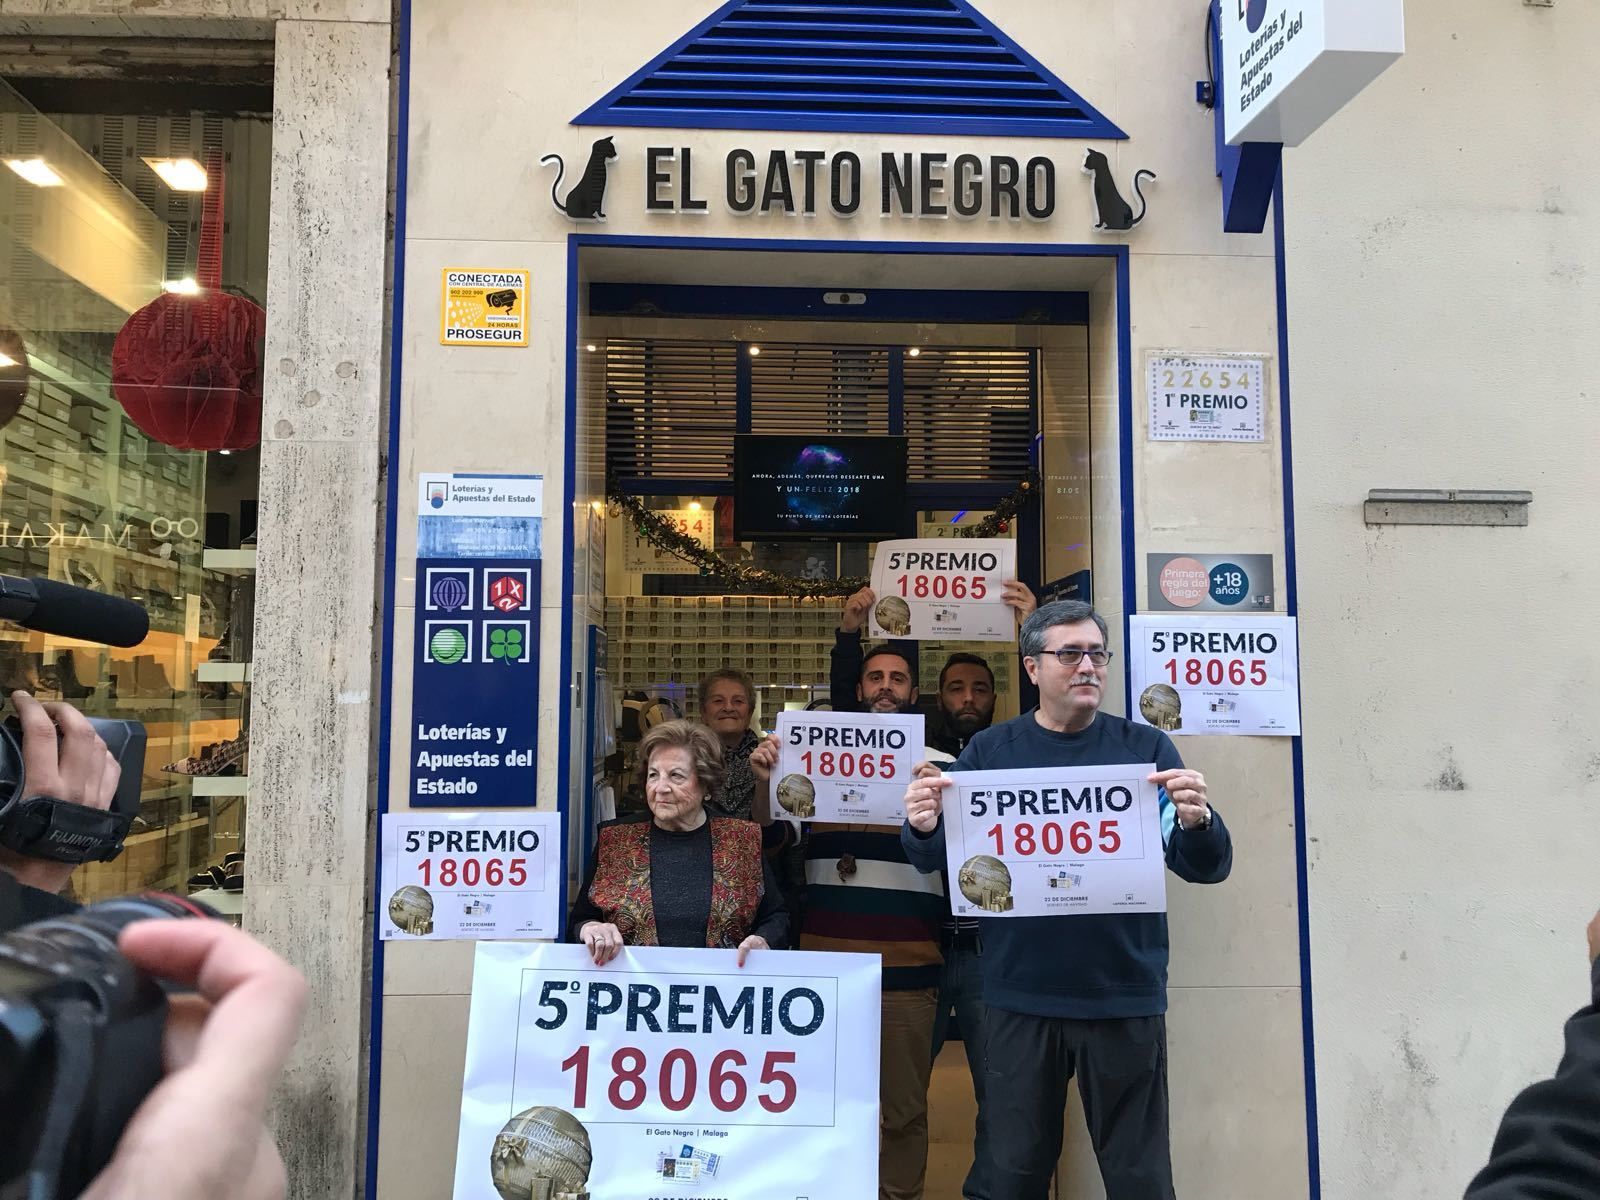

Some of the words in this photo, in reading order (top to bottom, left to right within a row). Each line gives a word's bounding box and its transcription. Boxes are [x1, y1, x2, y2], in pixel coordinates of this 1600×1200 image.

[1239, 19, 1278, 70] Loterías
[1280, 8, 1287, 31] y
[1240, 35, 1285, 91] Apuestas
[1286, 10, 1303, 42] del
[1240, 71, 1273, 113] Estado
[646, 147, 708, 212] EL
[726, 148, 862, 215] GATO
[881, 152, 1056, 219] NEGRO
[449, 273, 523, 284] CONECTADA
[447, 328, 522, 340] PROSEGUR
[1162, 369, 1250, 390] 22654
[1180, 393, 1248, 410] PREMIO
[452, 484, 486, 492] Loterías
[488, 486, 494, 494] y
[452, 494, 490, 503] Apuestas
[493, 494, 506, 502] del
[508, 495, 536, 503] Estado
[776, 485, 782, 493] Y
[837, 485, 860, 493] 2018
[905, 552, 998, 572] PREMIO
[1164, 568, 1205, 579] Primera
[897, 574, 987, 600] 18065
[1162, 578, 1189, 590] regla
[1191, 578, 1209, 588] del
[1213, 572, 1242, 587] +18
[1215, 585, 1241, 595] años
[1168, 587, 1202, 599] juego:
[1173, 631, 1278, 654] PREMIO
[1164, 658, 1268, 686] 18065
[418, 722, 492, 740] Loterías
[496, 727, 508, 745] y
[808, 726, 906, 750] PREMIO
[416, 750, 500, 772] Apuestas
[504, 749, 533, 767] del
[800, 750, 896, 779] 18065
[416, 776, 478, 795] Estado
[996, 785, 1133, 817] PREMIO
[428, 829, 540, 853] PREMIO
[987, 819, 1121, 856] 18065
[418, 858, 528, 887] 18065
[534, 980, 582, 1031] 5º
[585, 982, 825, 1037] PREMIO
[561, 1045, 798, 1114] 18065
[646, 1128, 653, 1136] El
[654, 1128, 671, 1136] Gato
[673, 1129, 694, 1137] Negro
[702, 1130, 729, 1138] Malaga
